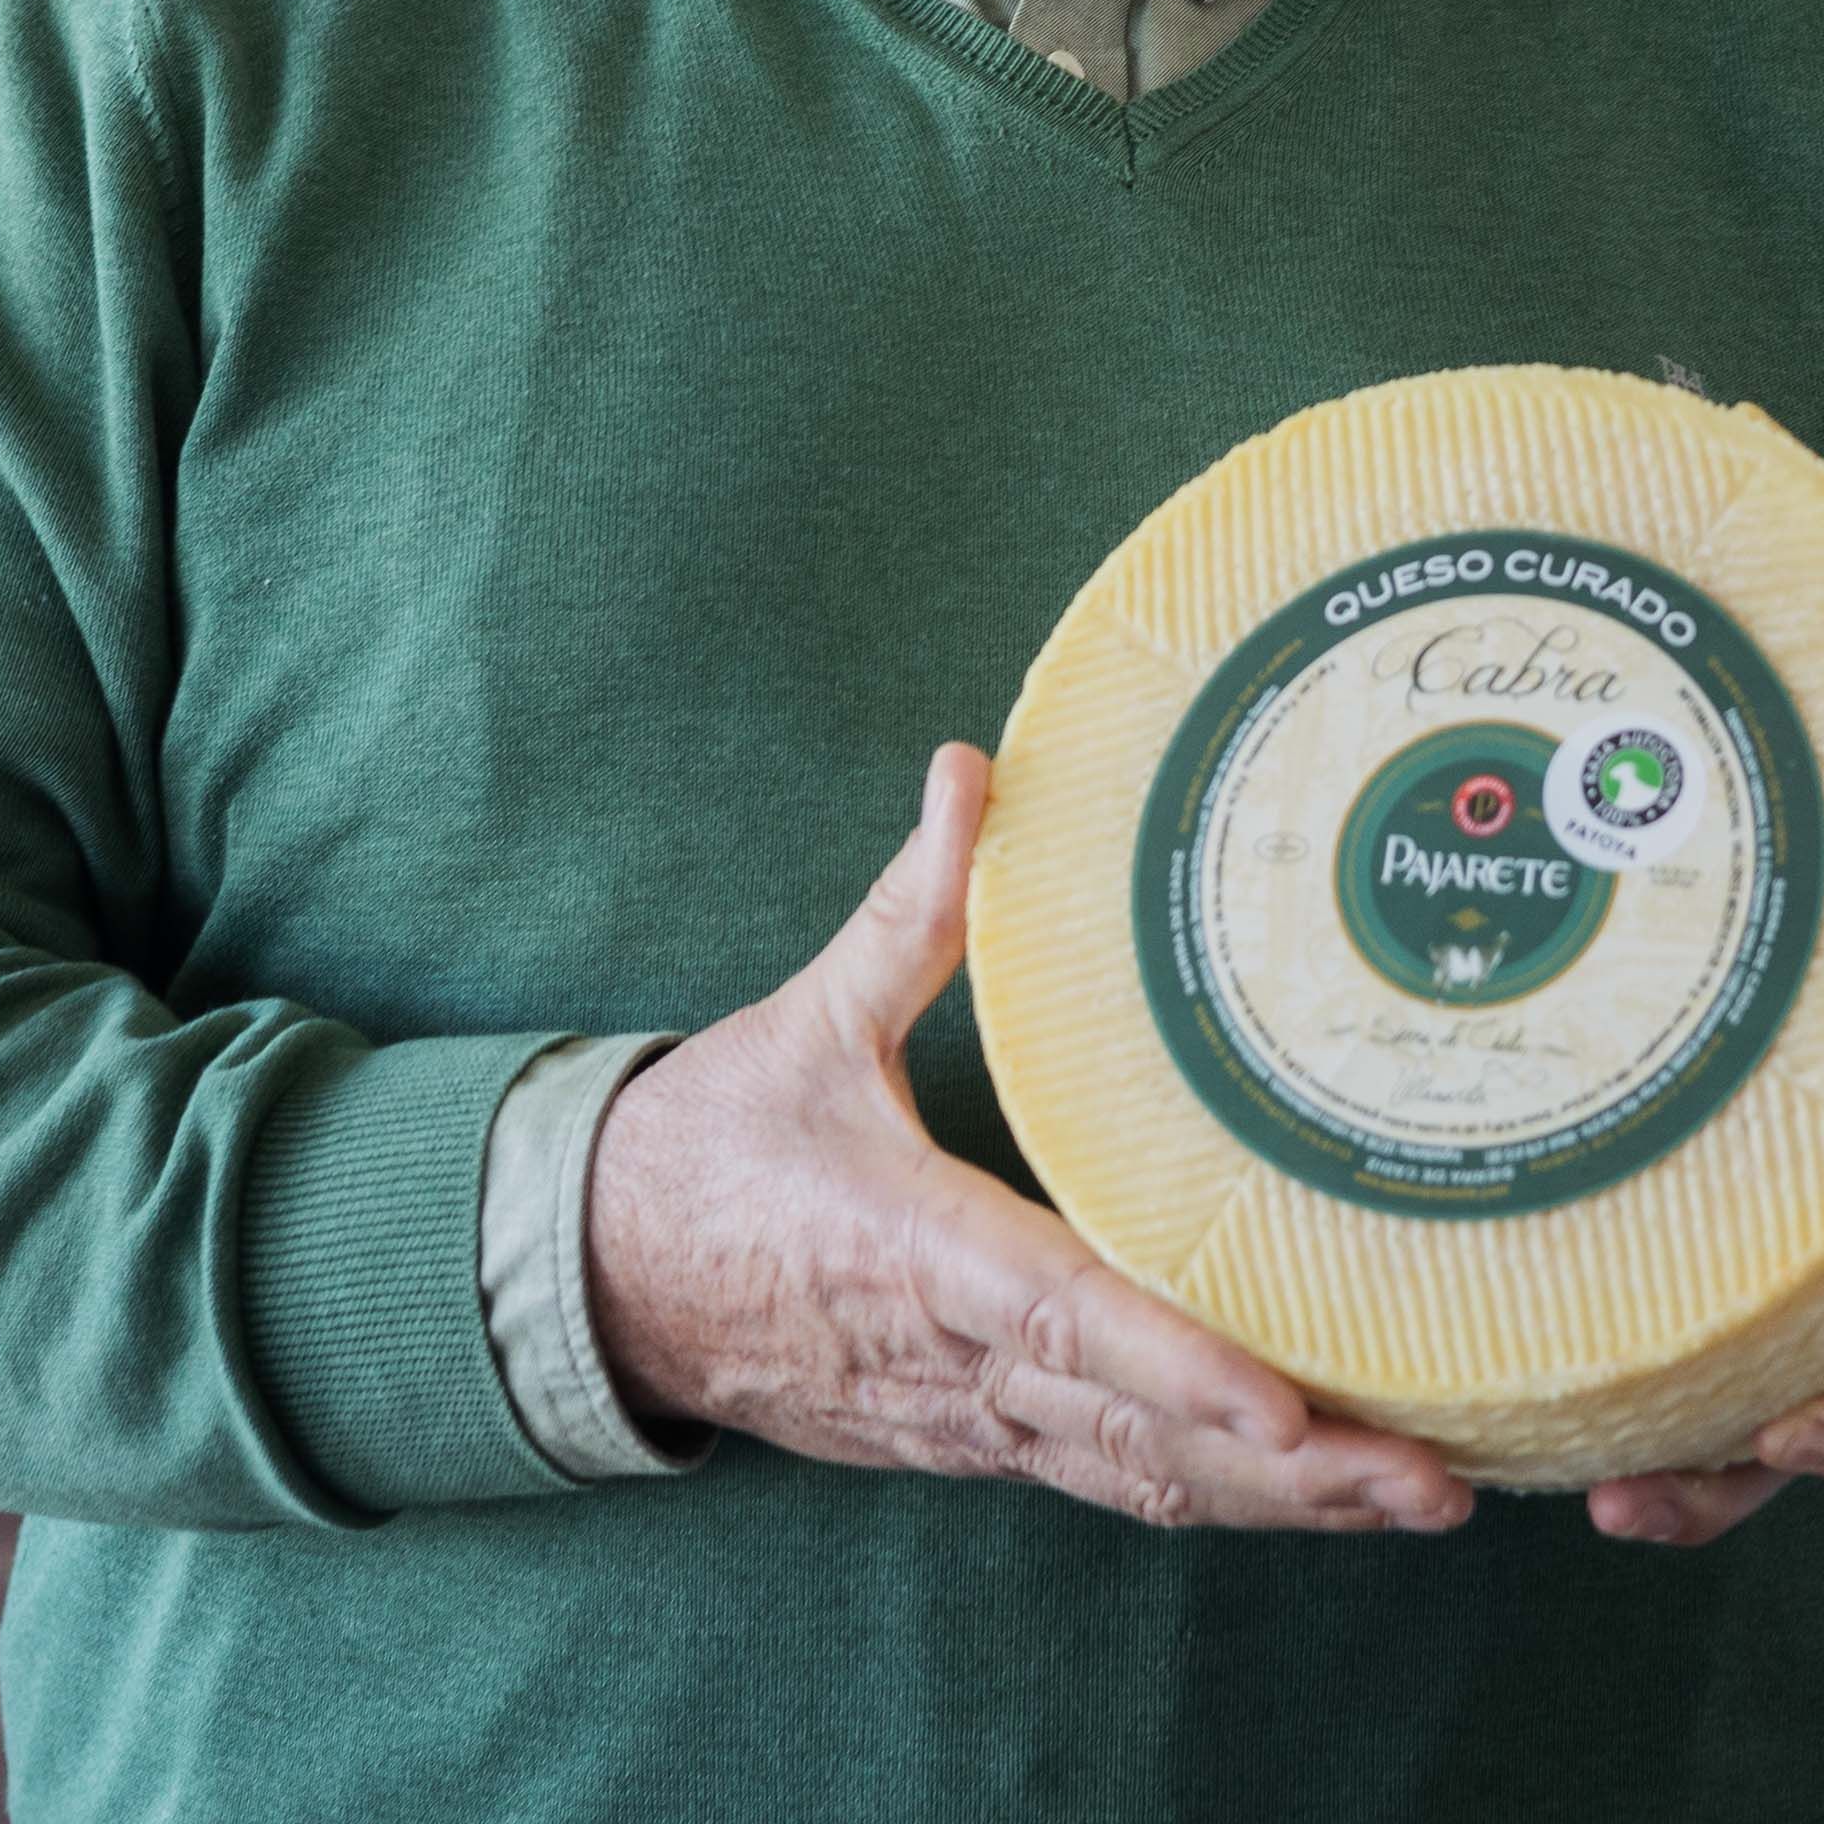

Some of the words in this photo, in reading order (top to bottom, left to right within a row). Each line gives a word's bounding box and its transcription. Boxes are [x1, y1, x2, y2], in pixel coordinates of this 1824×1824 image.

[1324, 550, 1494, 626] QUESO
[1504, 549, 1697, 647] CURADO
[1396, 618, 1626, 708] Cabra
[1565, 818, 1637, 859] PAYOYA
[1591, 796, 1640, 830] 100%
[1380, 833, 1572, 899] PAJARETE
